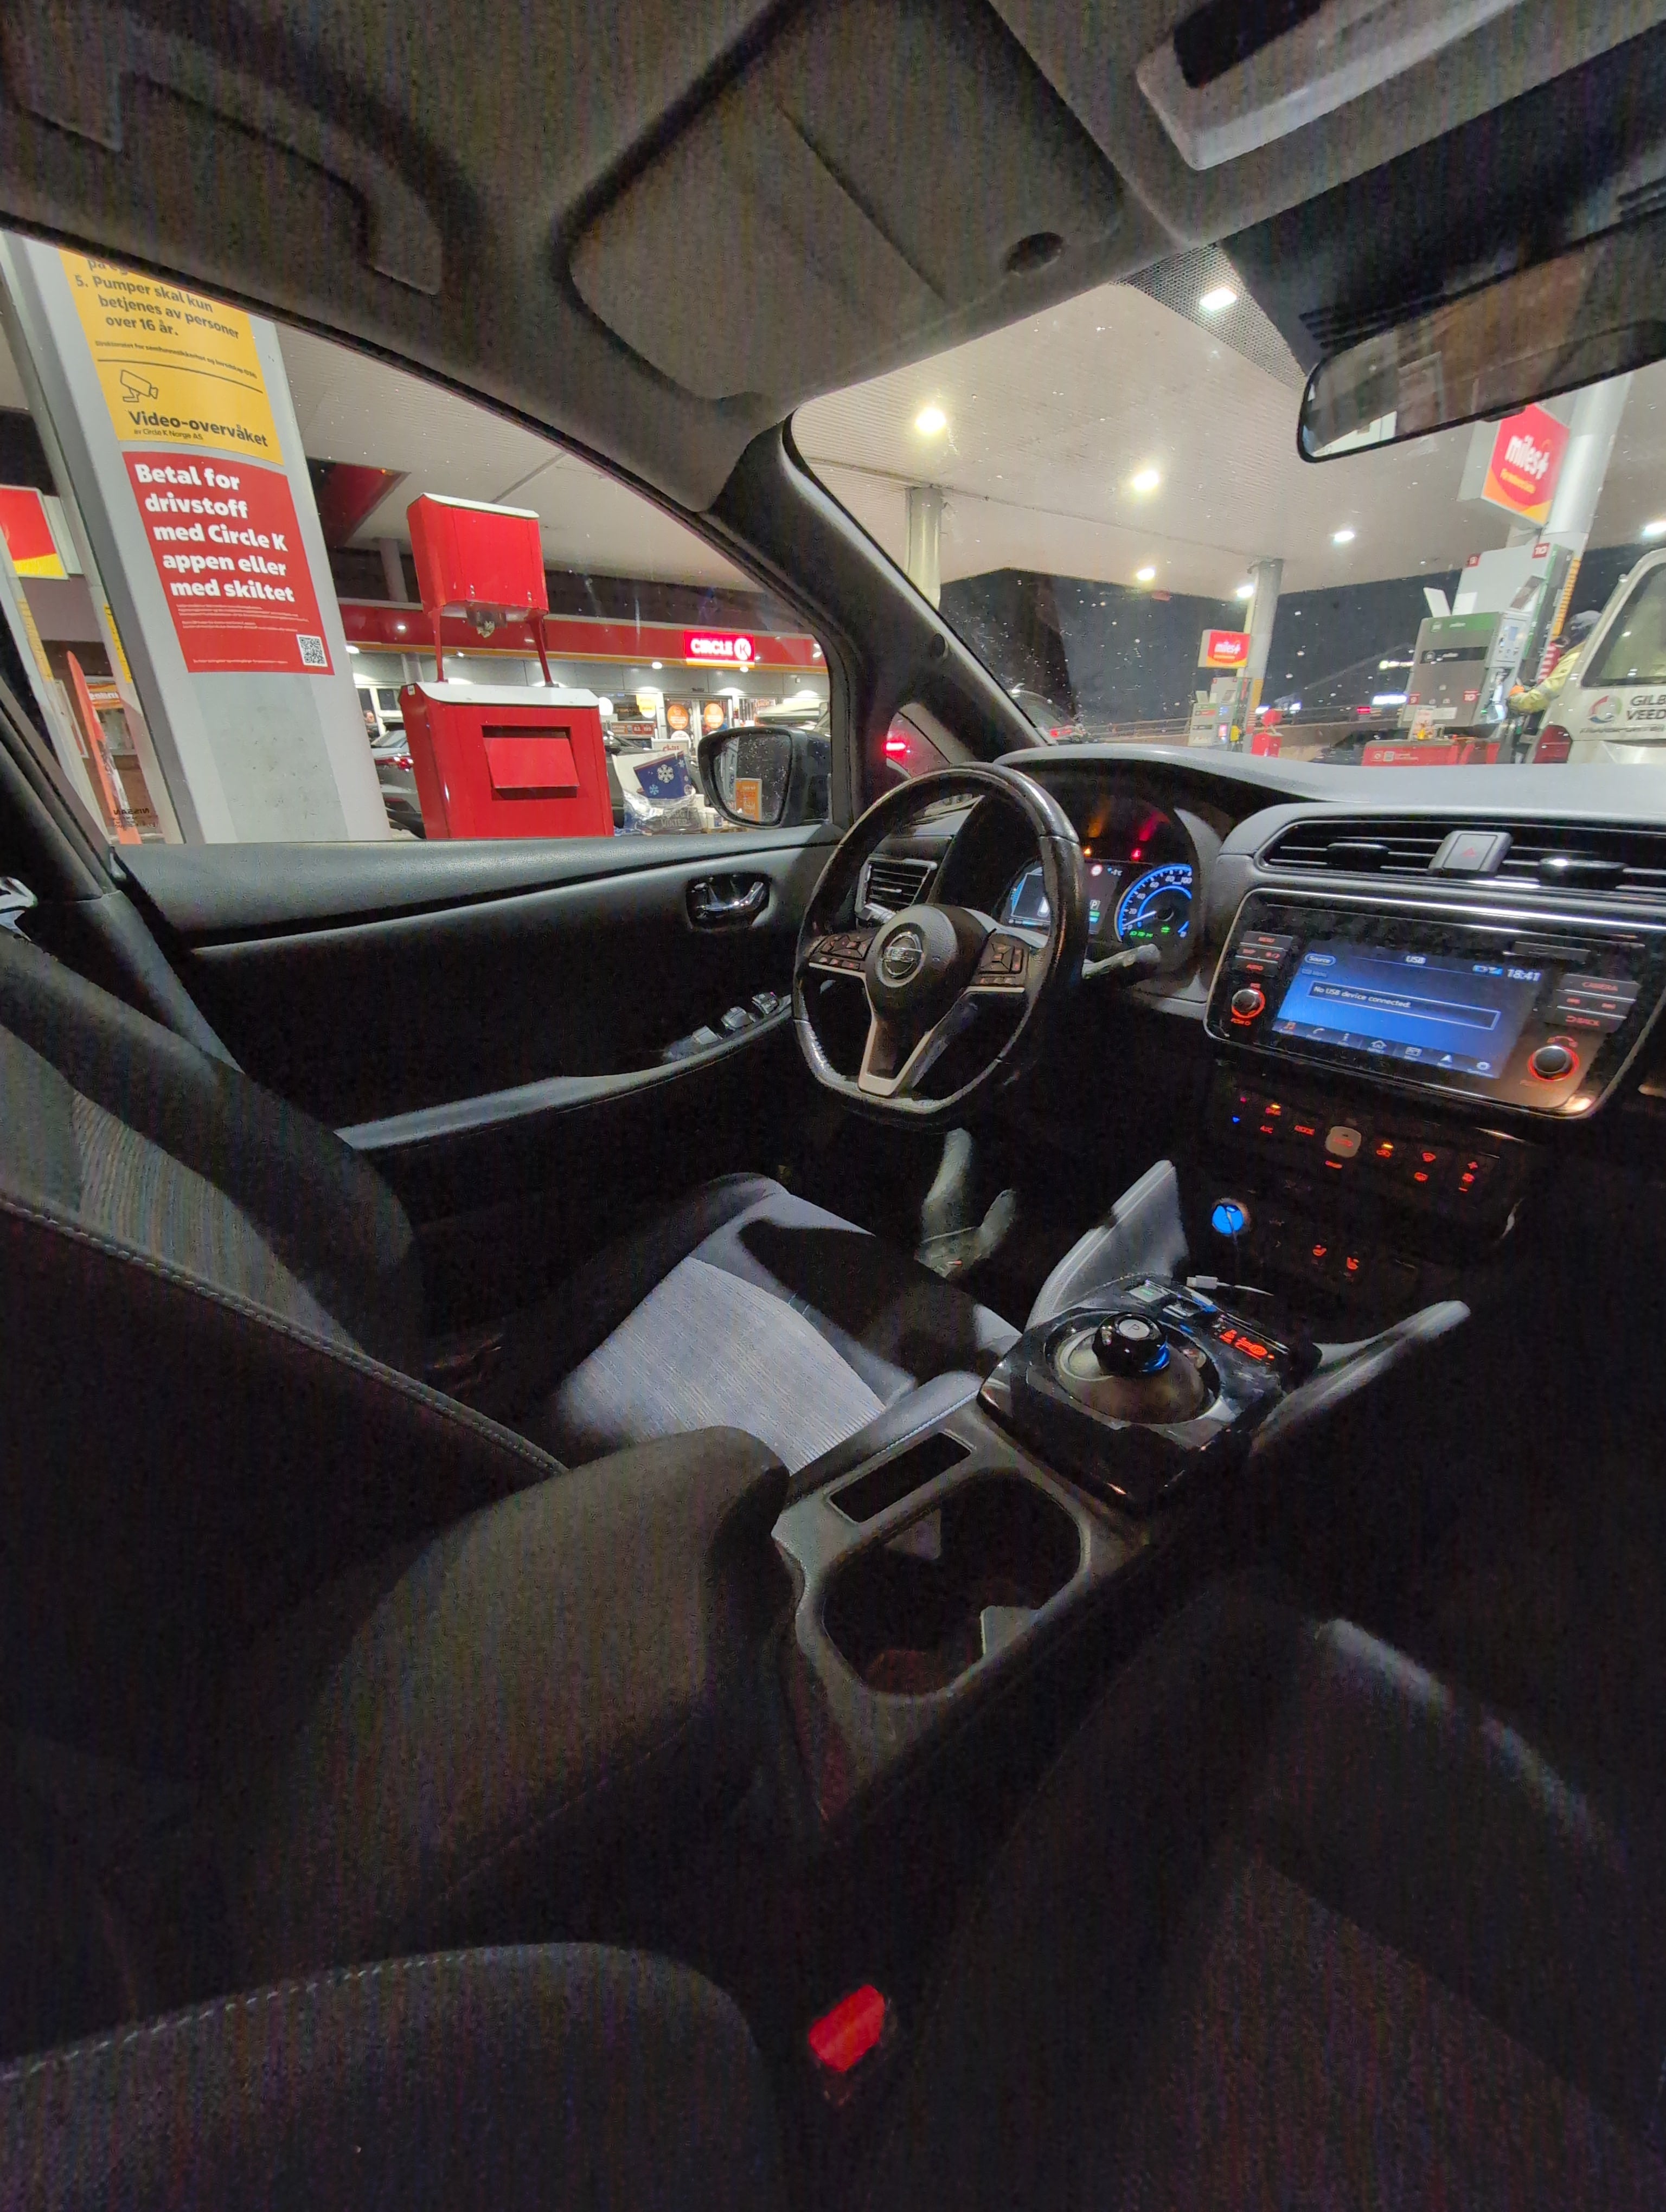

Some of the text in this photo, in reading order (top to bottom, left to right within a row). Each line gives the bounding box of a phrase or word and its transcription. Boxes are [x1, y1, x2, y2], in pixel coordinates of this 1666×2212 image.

[75, 274, 213, 313] 5. Pumper skal kun
[98, 294, 239, 339] betjenes av personer
[105, 316, 179, 336] over 16 år.
[128, 410, 268, 447] Video-overvåket
[134, 464, 240, 491] Betal for
[144, 491, 248, 519] drivstoff
[152, 523, 289, 551] med Circle K
[1534, 545, 1548, 555] 10
[162, 554, 286, 576] appen eller
[169, 578, 296, 602] med skiltet
[690, 638, 733, 656] CIRCLE
[1464, 693, 1477, 702] 10
[1308, 955, 1331, 963] Source
[1406, 955, 1426, 964] USB
[1507, 969, 1541, 981] 18:41
[1341, 992, 1367, 1000] device
[1368, 995, 1411, 1008] connected.
